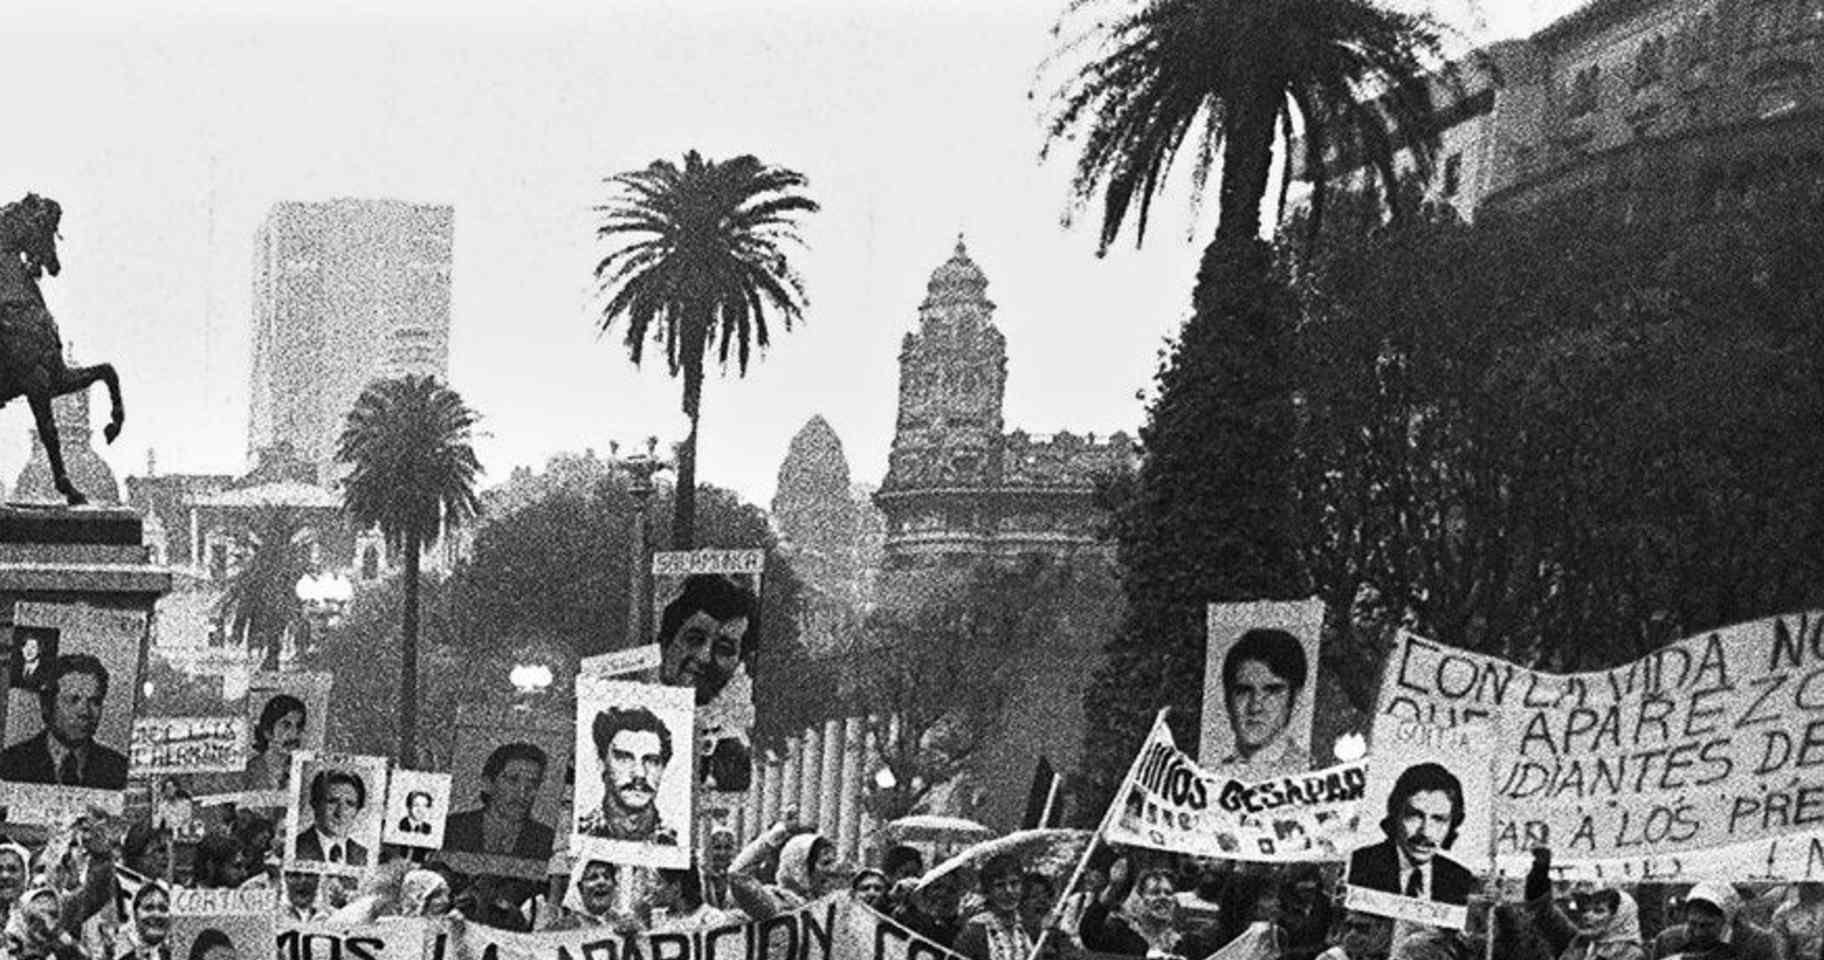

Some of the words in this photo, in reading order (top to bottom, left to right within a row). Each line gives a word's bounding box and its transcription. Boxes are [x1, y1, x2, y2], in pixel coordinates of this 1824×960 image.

[1397, 636, 1513, 705] CON
[1609, 632, 1727, 700] VIDA
[1219, 764, 1369, 812] DESAPAR
[1569, 814, 1596, 850] A
[1615, 804, 1700, 848] LOS
[1727, 786, 1824, 834] PRE
